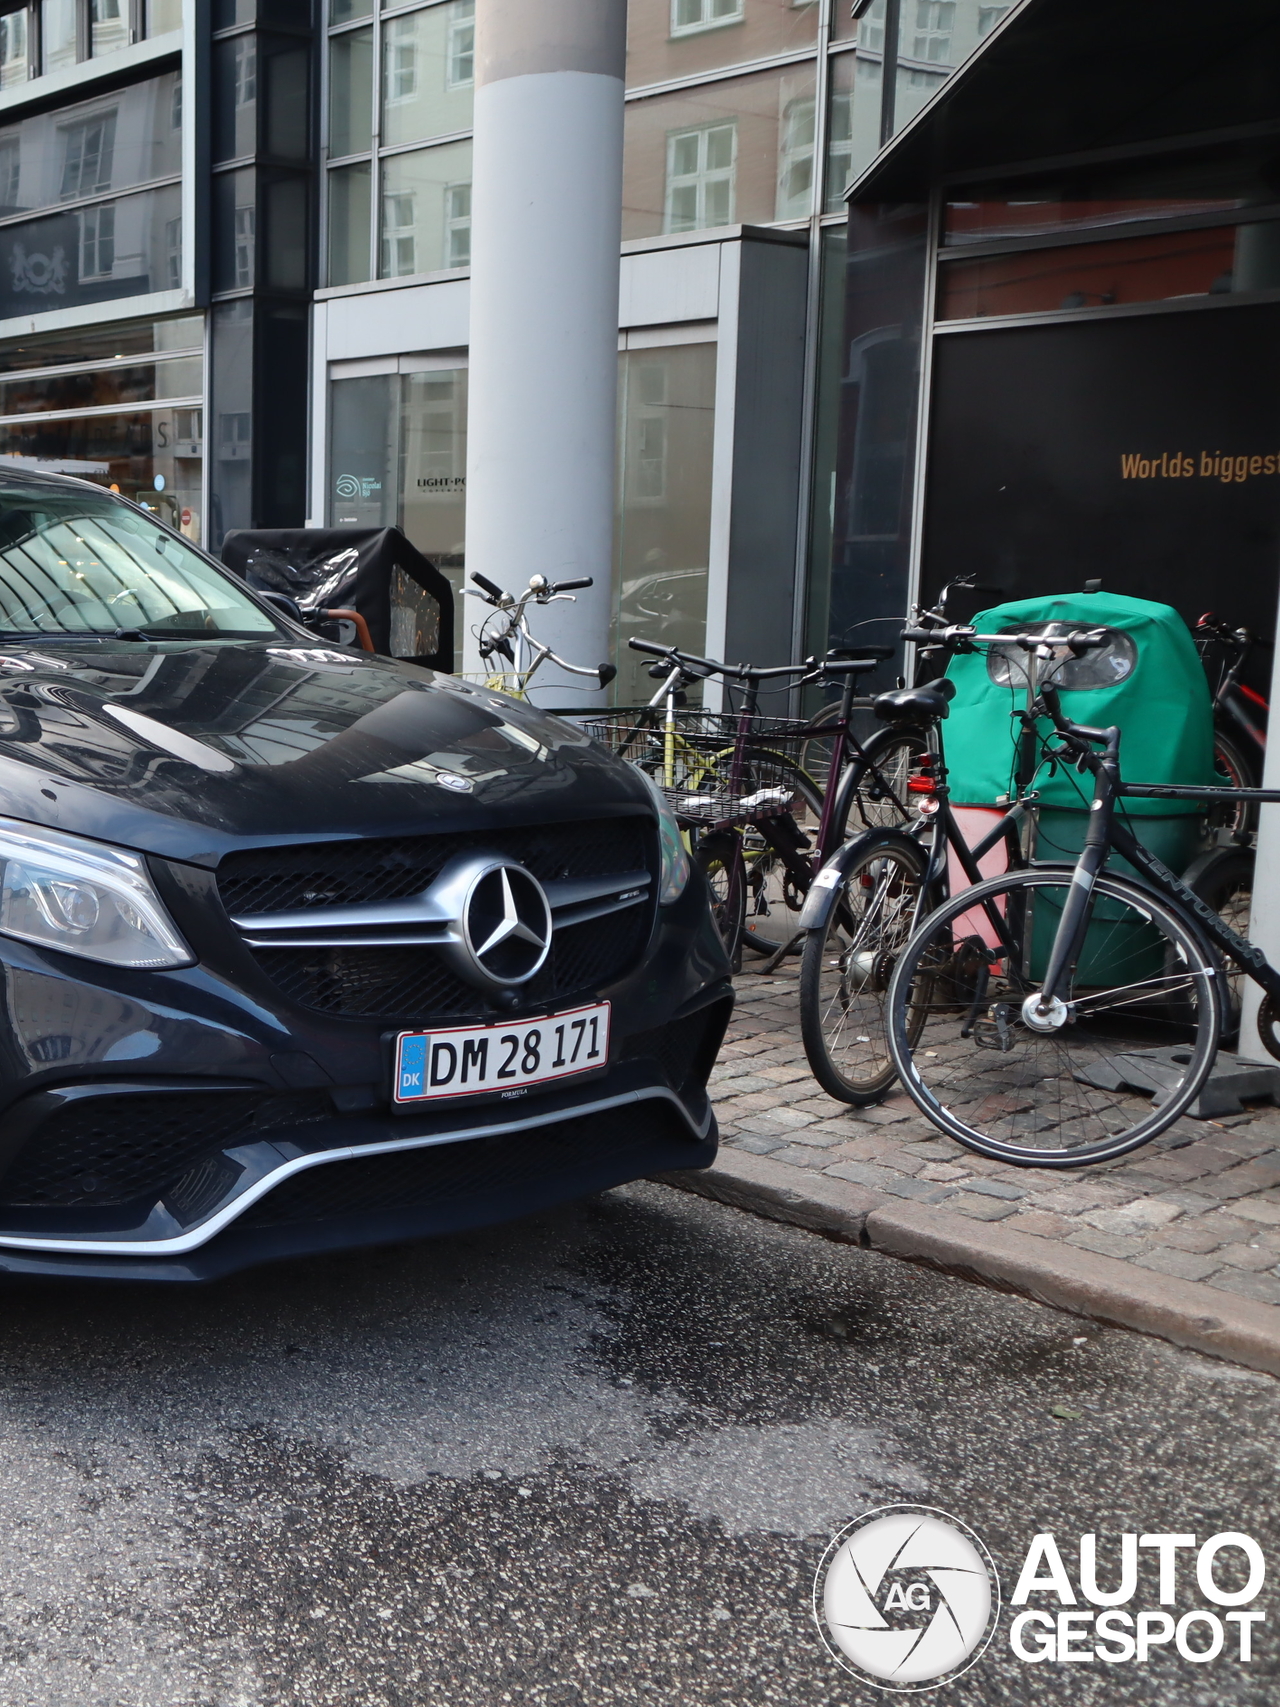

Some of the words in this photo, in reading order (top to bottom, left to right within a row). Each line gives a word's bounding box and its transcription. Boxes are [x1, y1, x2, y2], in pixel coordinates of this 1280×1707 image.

[1121, 451, 1194, 480] Worlds
[430, 1037, 489, 1087] DM
[497, 1029, 542, 1079] 28
[552, 1016, 599, 1068] 171
[402, 1072, 420, 1087] DK
[501, 1088, 528, 1098] FORMULA
